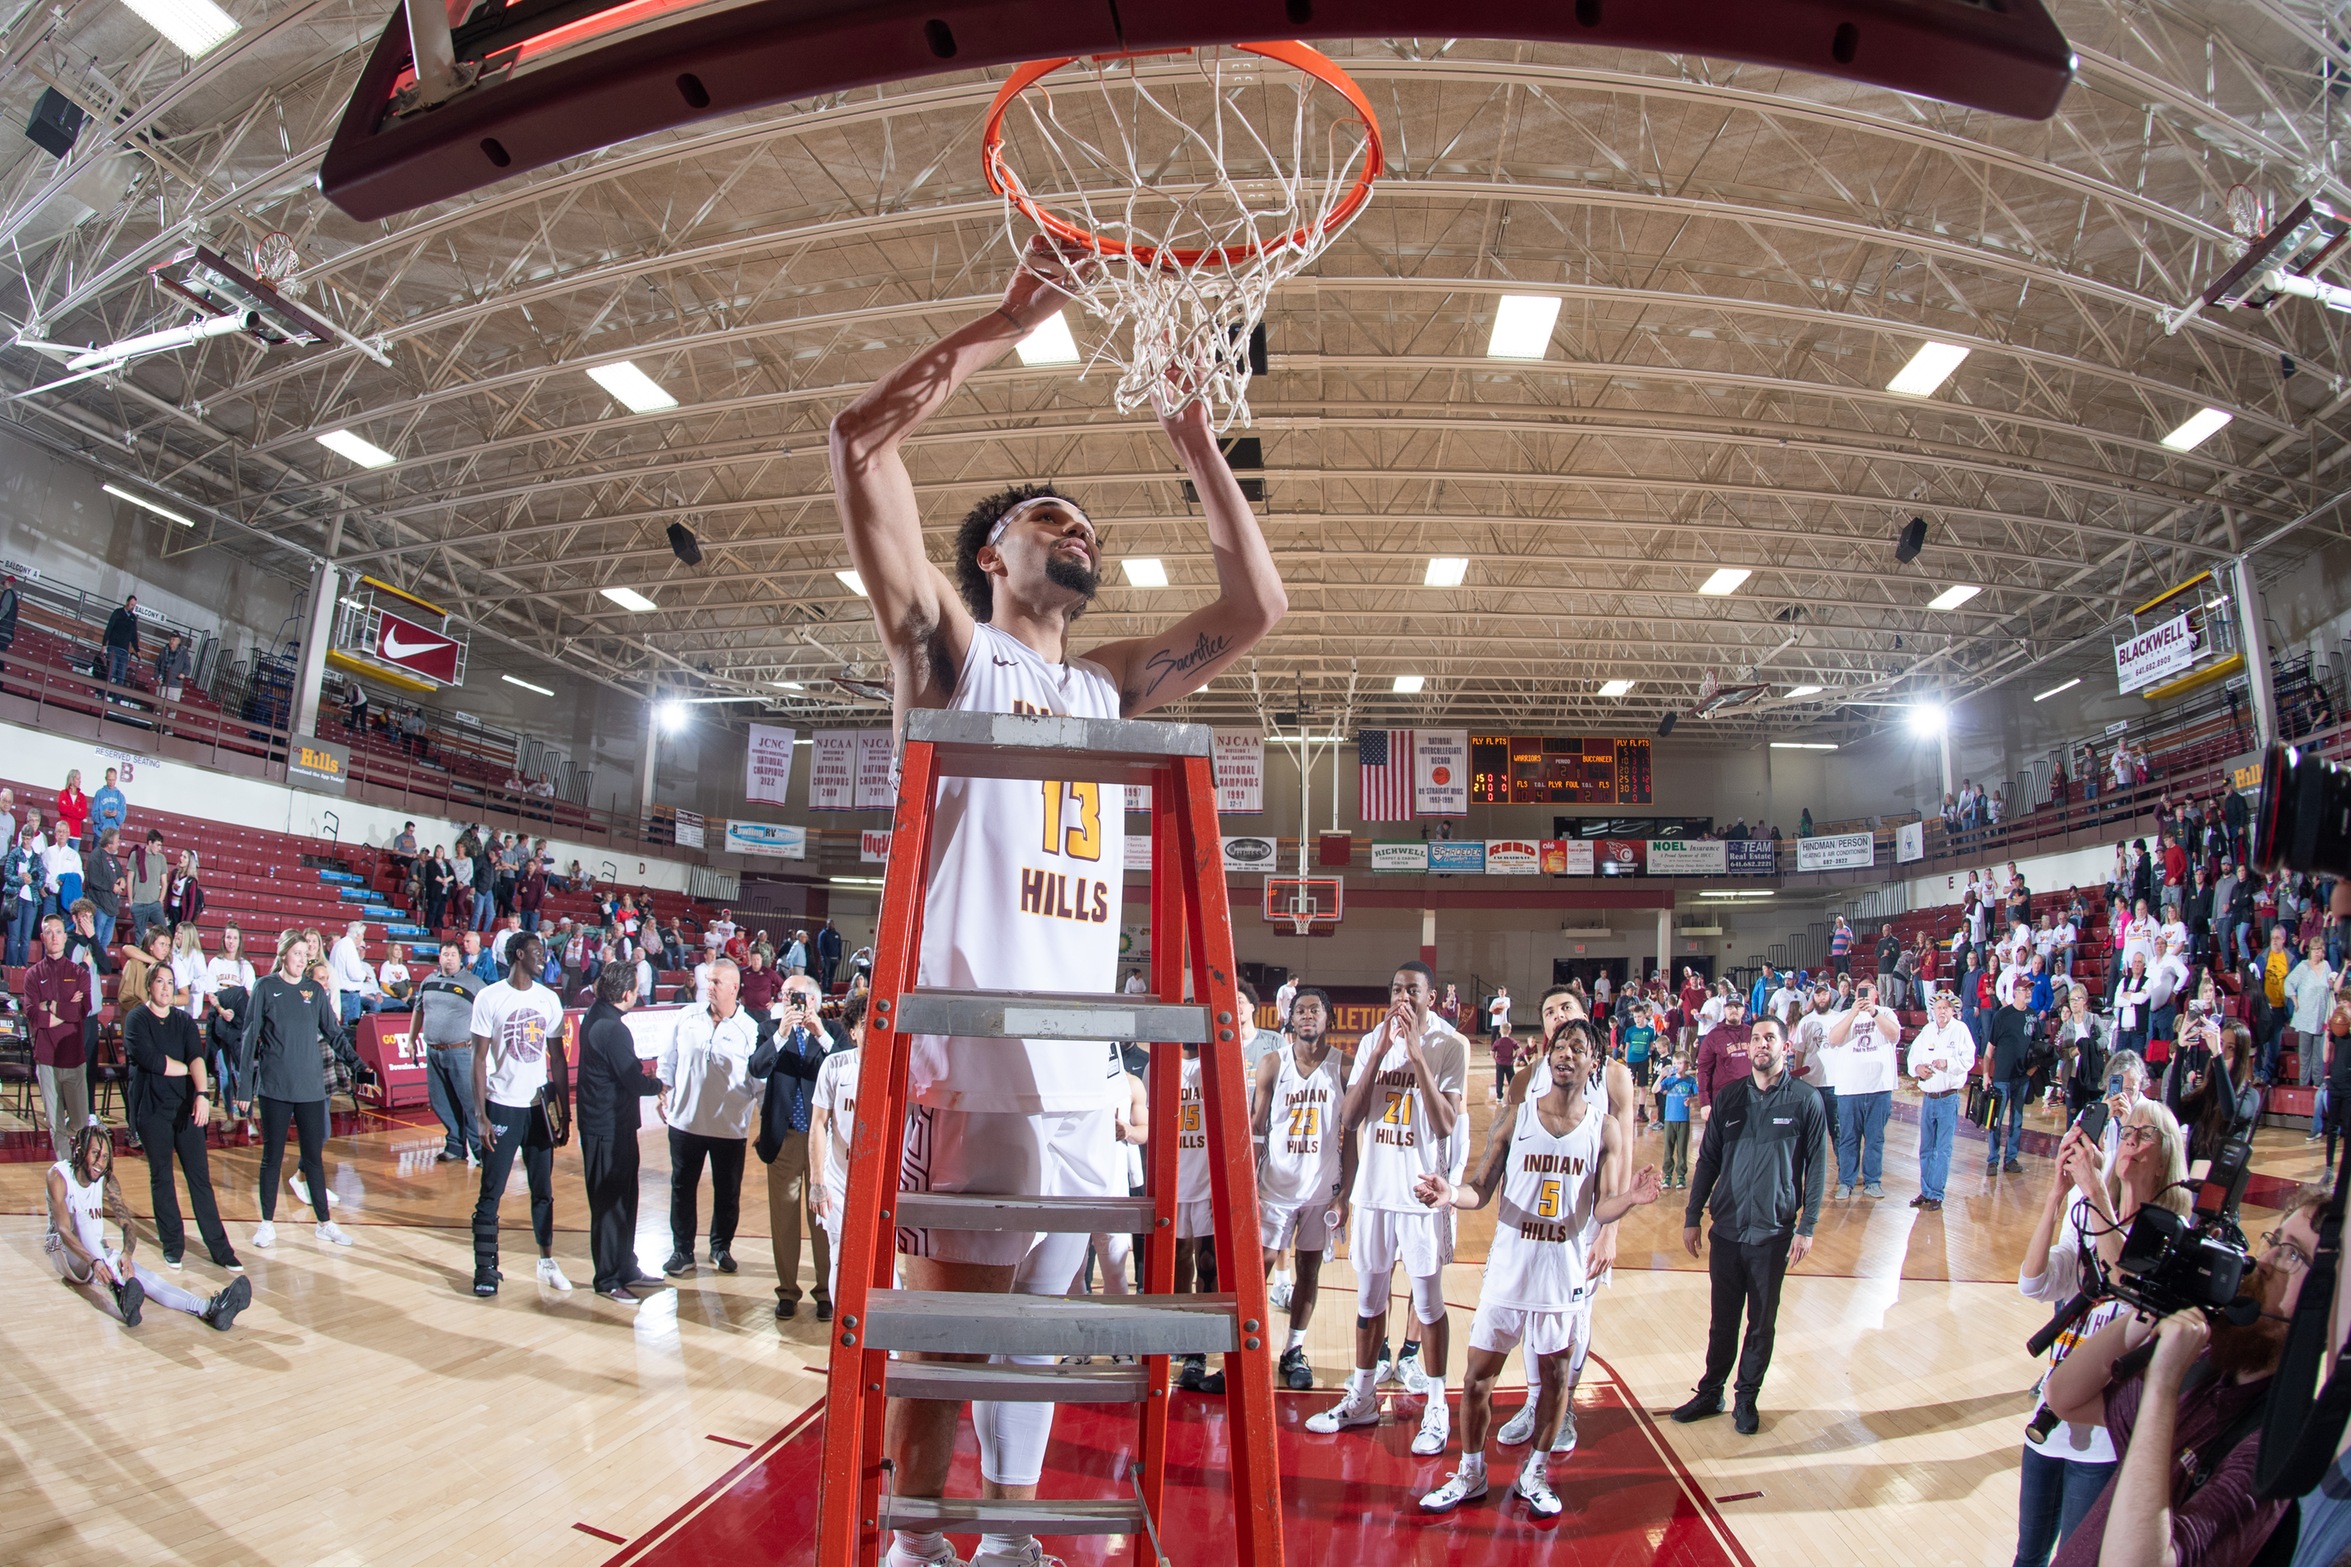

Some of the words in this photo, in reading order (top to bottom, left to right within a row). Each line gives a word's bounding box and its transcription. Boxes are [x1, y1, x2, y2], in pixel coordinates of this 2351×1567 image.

[5, 560, 31, 574] BALCONY
[135, 607, 158, 620] BALCONY
[2119, 622, 2184, 666] BLACKWELL
[1146, 632, 1233, 697] Sacrifice
[2136, 655, 2171, 676] 641.682.8909
[458, 713, 472, 722] BALCONY
[759, 738, 785, 750] JCNC
[816, 738, 852, 748] NJCAA
[1217, 736, 1259, 746] NJCAA
[1419, 747, 1462, 756] INTERCOLLEGIATE
[96, 748, 131, 762] RESERVED
[133, 756, 160, 768] SEATING
[300, 748, 338, 773] Hills
[757, 756, 783, 767] NATIONAL
[120, 762, 134, 783] B
[754, 766, 784, 778] CHAMPIONS
[816, 765, 846, 774] NATIONAL
[863, 765, 889, 774] NATIONA
[1218, 766, 1255, 774] NATIONAL
[1561, 766, 1566, 776] 2
[1620, 766, 1629, 774] 20
[1476, 774, 1484, 782] 15
[1488, 774, 1493, 782] 0
[1619, 775, 1629, 783] 25
[1632, 775, 1636, 783] 5
[1642, 775, 1650, 783] 12
[2234, 764, 2263, 788] Hill
[813, 778, 849, 786] CHAMPIONS
[1220, 778, 1258, 786] HAMPIONS
[1474, 783, 1484, 792] 21
[1488, 784, 1493, 792] 0
[1502, 784, 1506, 792] 0
[1124, 788, 1141, 797] 1997
[1228, 790, 1244, 799] 1999
[1488, 792, 1493, 801] 0
[1536, 791, 1543, 800] 4
[1585, 791, 1591, 801] 2
[1632, 794, 1638, 802] 0
[1042, 780, 1101, 862] 13
[1434, 848, 1481, 856] SCHROEDER
[1490, 842, 1536, 856] REED
[1653, 842, 1686, 851] NOEL
[1743, 842, 1772, 852] TEAM
[1837, 848, 1868, 856] CONDITIONING
[1375, 848, 1426, 858] RICHWELL
[640, 862, 645, 874] D
[1948, 876, 1954, 890] E
[1020, 867, 1108, 924] HILLS
[383, 1035, 396, 1044] GO
[1376, 1070, 1420, 1088] INDIA
[1286, 1090, 1328, 1106] INDIAN
[1384, 1092, 1413, 1126] 21
[1289, 1108, 1319, 1136] 23
[1376, 1128, 1414, 1146] HILLS
[1287, 1140, 1318, 1154] HILLS
[1524, 1154, 1584, 1176] INDIAN
[1538, 1180, 1560, 1217] 5
[1521, 1222, 1566, 1243] HILLS
